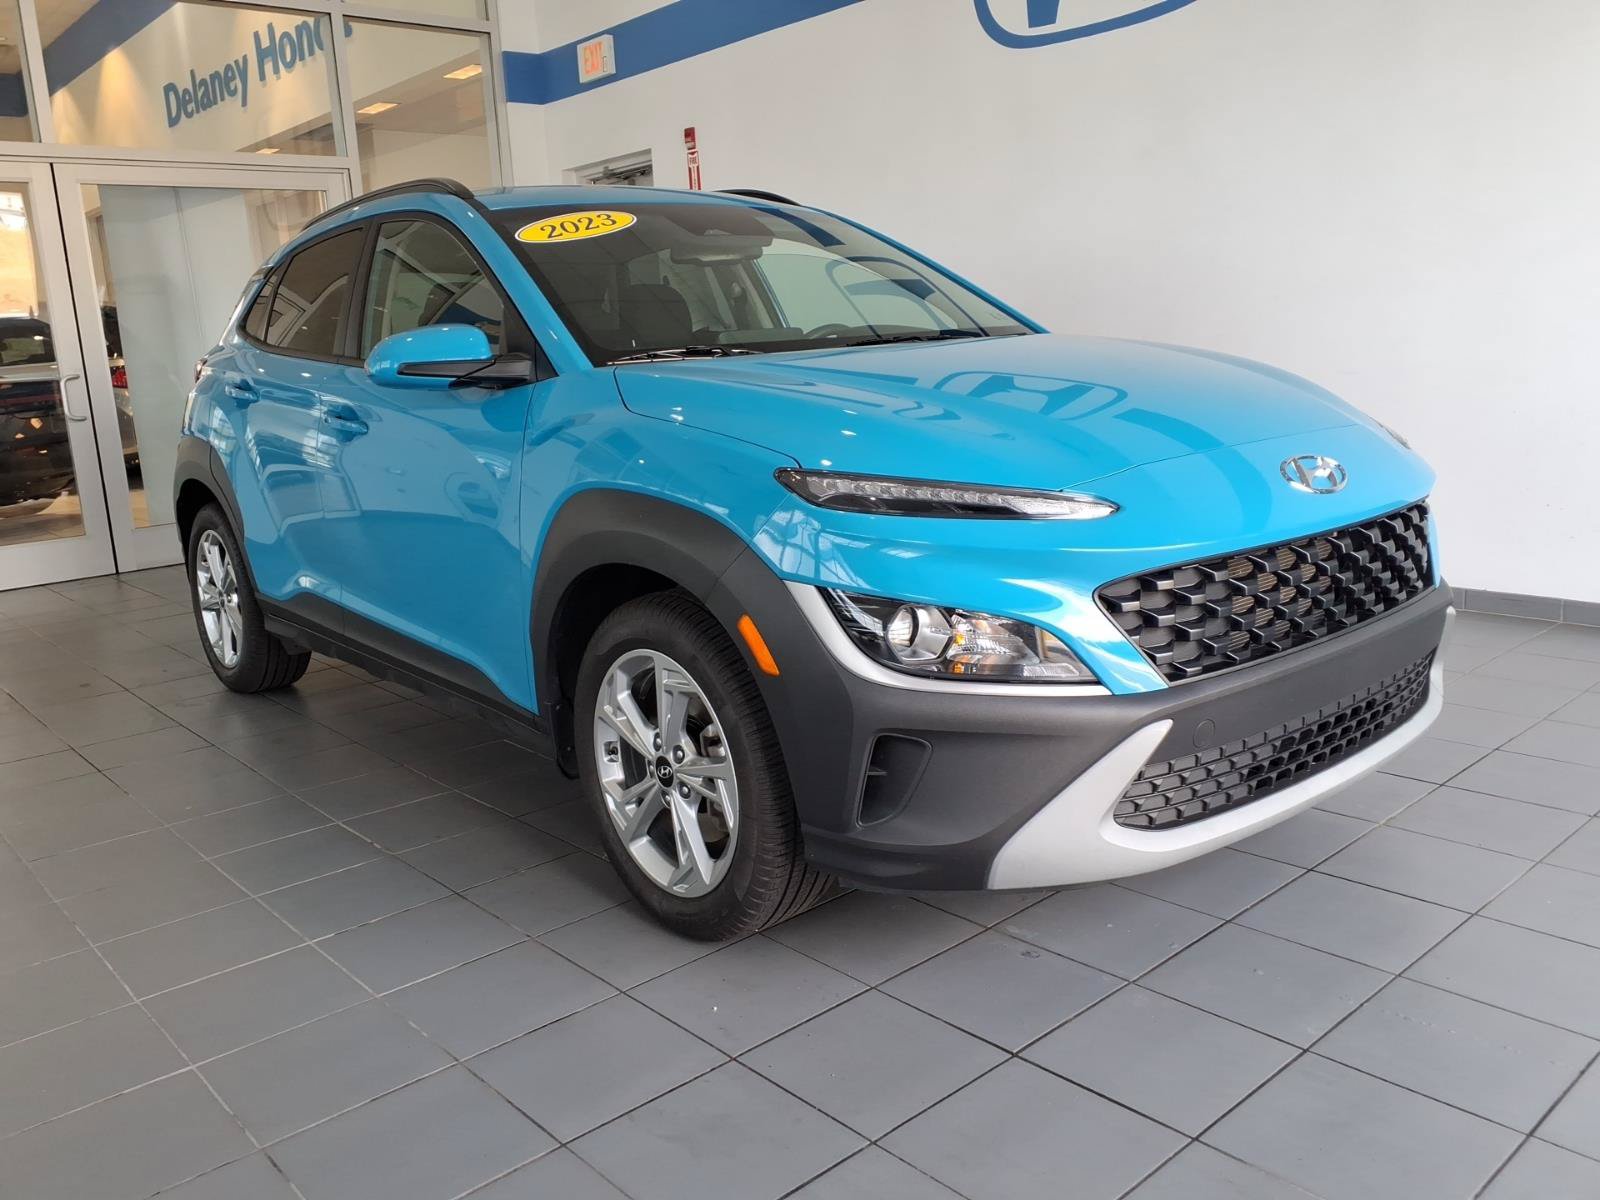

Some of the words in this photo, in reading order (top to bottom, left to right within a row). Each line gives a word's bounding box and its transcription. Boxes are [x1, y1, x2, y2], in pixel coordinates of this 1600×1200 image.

[163, 54, 248, 128] Delaney
[253, 17, 353, 82] Hon
[582, 41, 604, 75] EXIT
[540, 213, 617, 239] 2023
